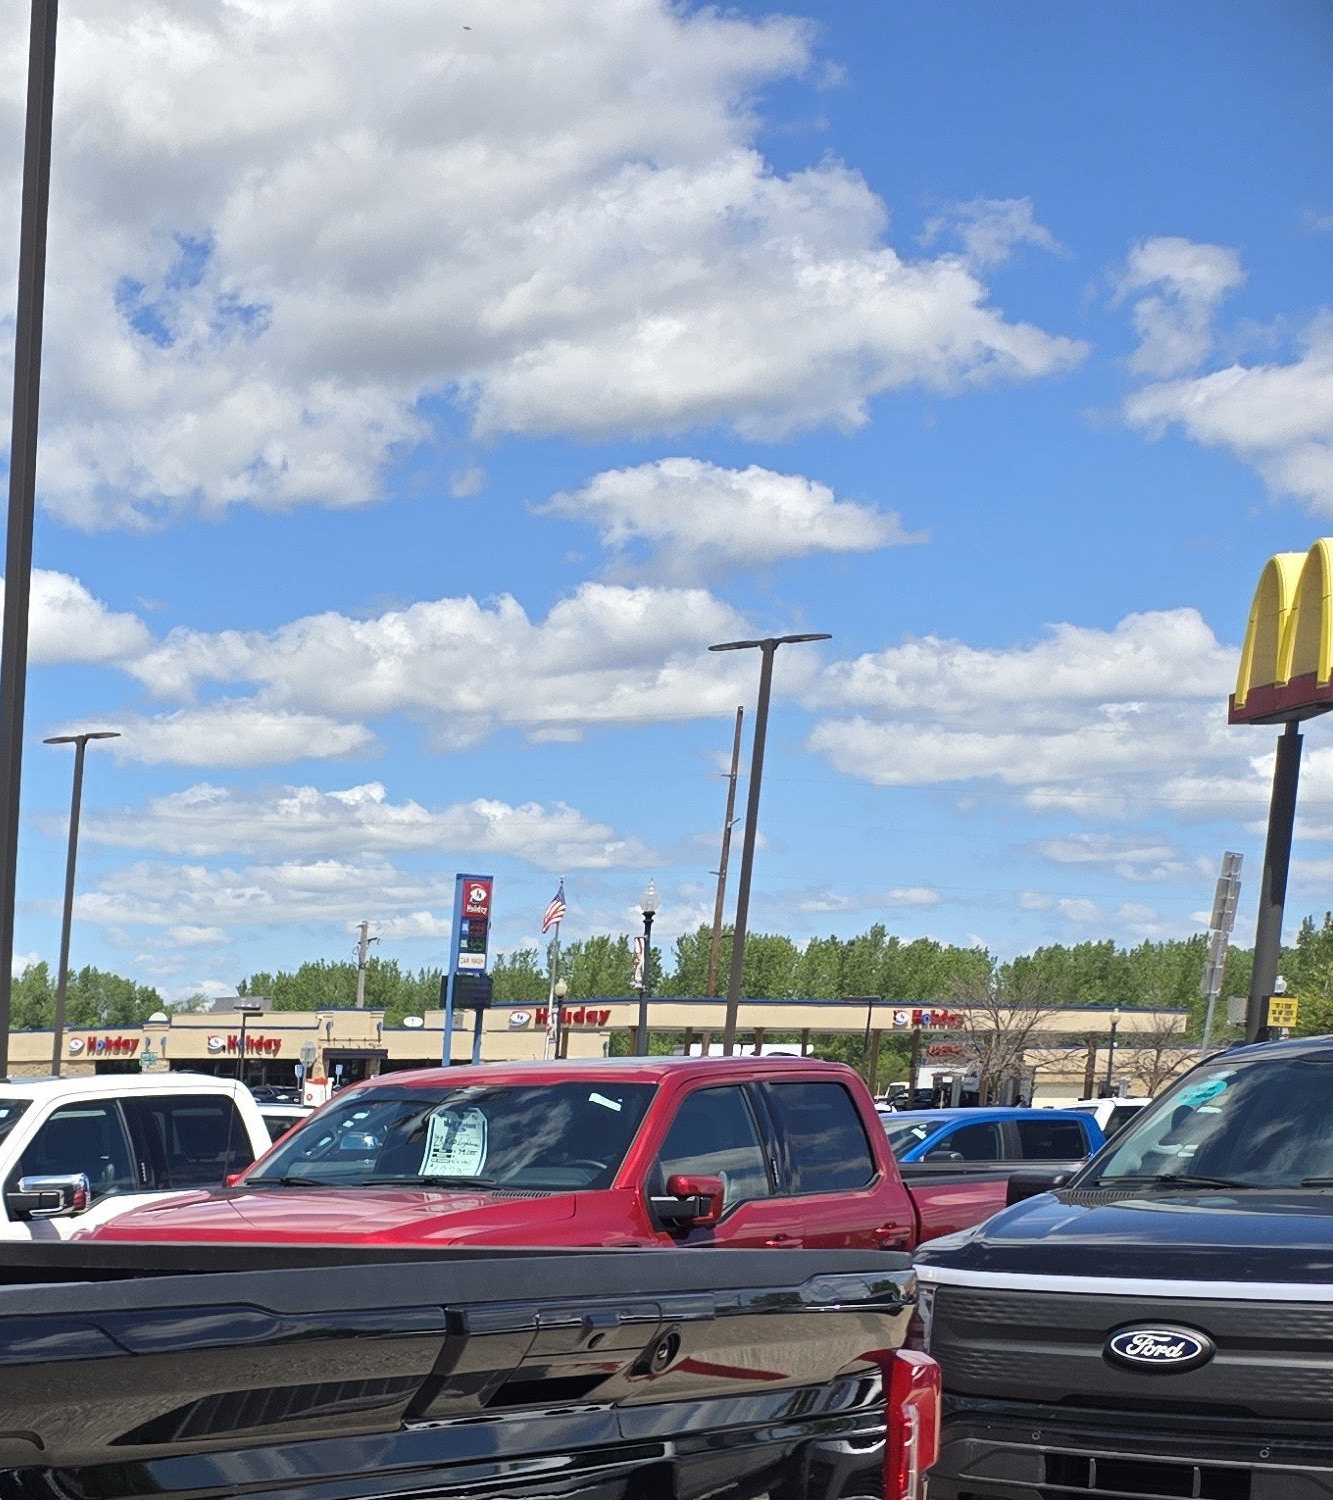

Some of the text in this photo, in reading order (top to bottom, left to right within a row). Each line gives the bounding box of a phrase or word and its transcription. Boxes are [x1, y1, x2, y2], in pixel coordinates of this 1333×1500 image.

[535, 1006, 611, 1026] Hliday
[86, 1036, 140, 1053] Holiday
[1126, 1334, 1186, 1358] Ford
